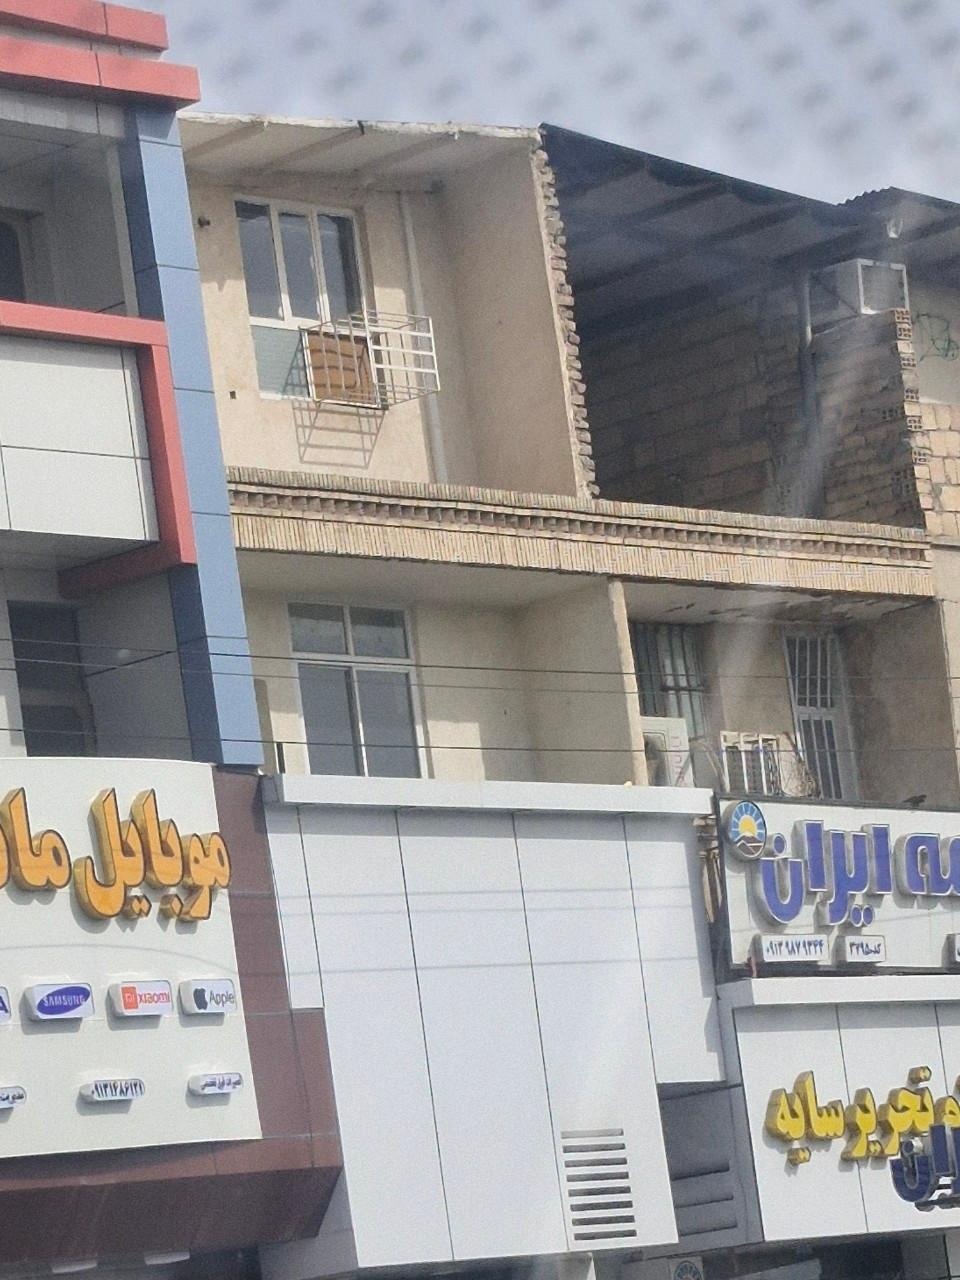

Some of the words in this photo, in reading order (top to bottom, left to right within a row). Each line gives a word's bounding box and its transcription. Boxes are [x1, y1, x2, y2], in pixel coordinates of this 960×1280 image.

[74, 787, 231, 920] موبایل
[759, 819, 892, 927] ایران
[43, 994, 85, 1007] SAMSUNG
[209, 990, 235, 1008] Apple
[766, 1070, 846, 1165] سایه
[840, 1065, 935, 1161] تحریر
